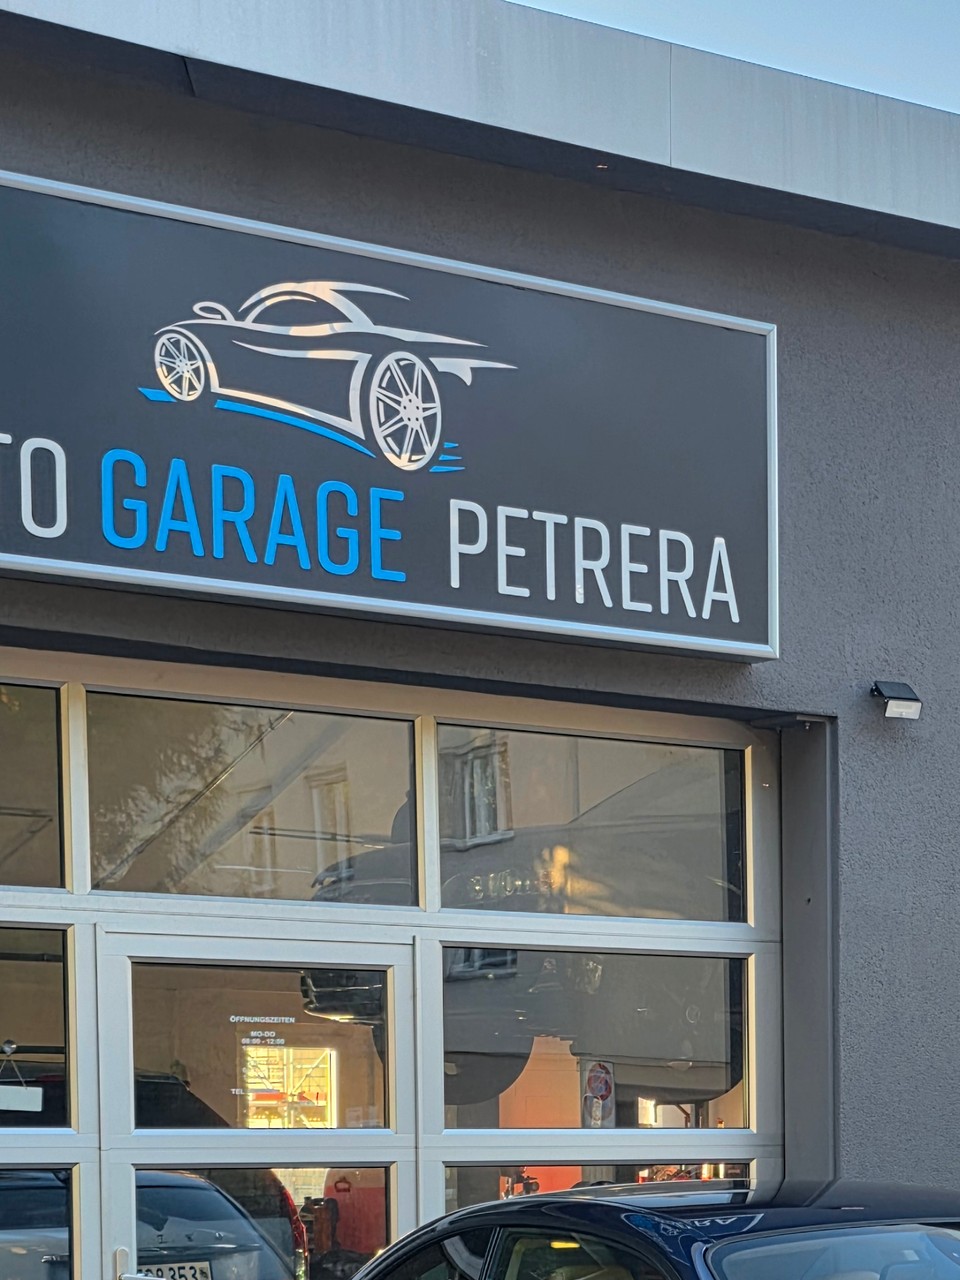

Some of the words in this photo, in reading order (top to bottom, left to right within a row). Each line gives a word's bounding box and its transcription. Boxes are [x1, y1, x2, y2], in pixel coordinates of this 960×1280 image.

[101, 448, 406, 582] GARAGE
[450, 498, 740, 623] PETRERA
[229, 1015, 295, 1023] ÖFFNUNGSZEITEN
